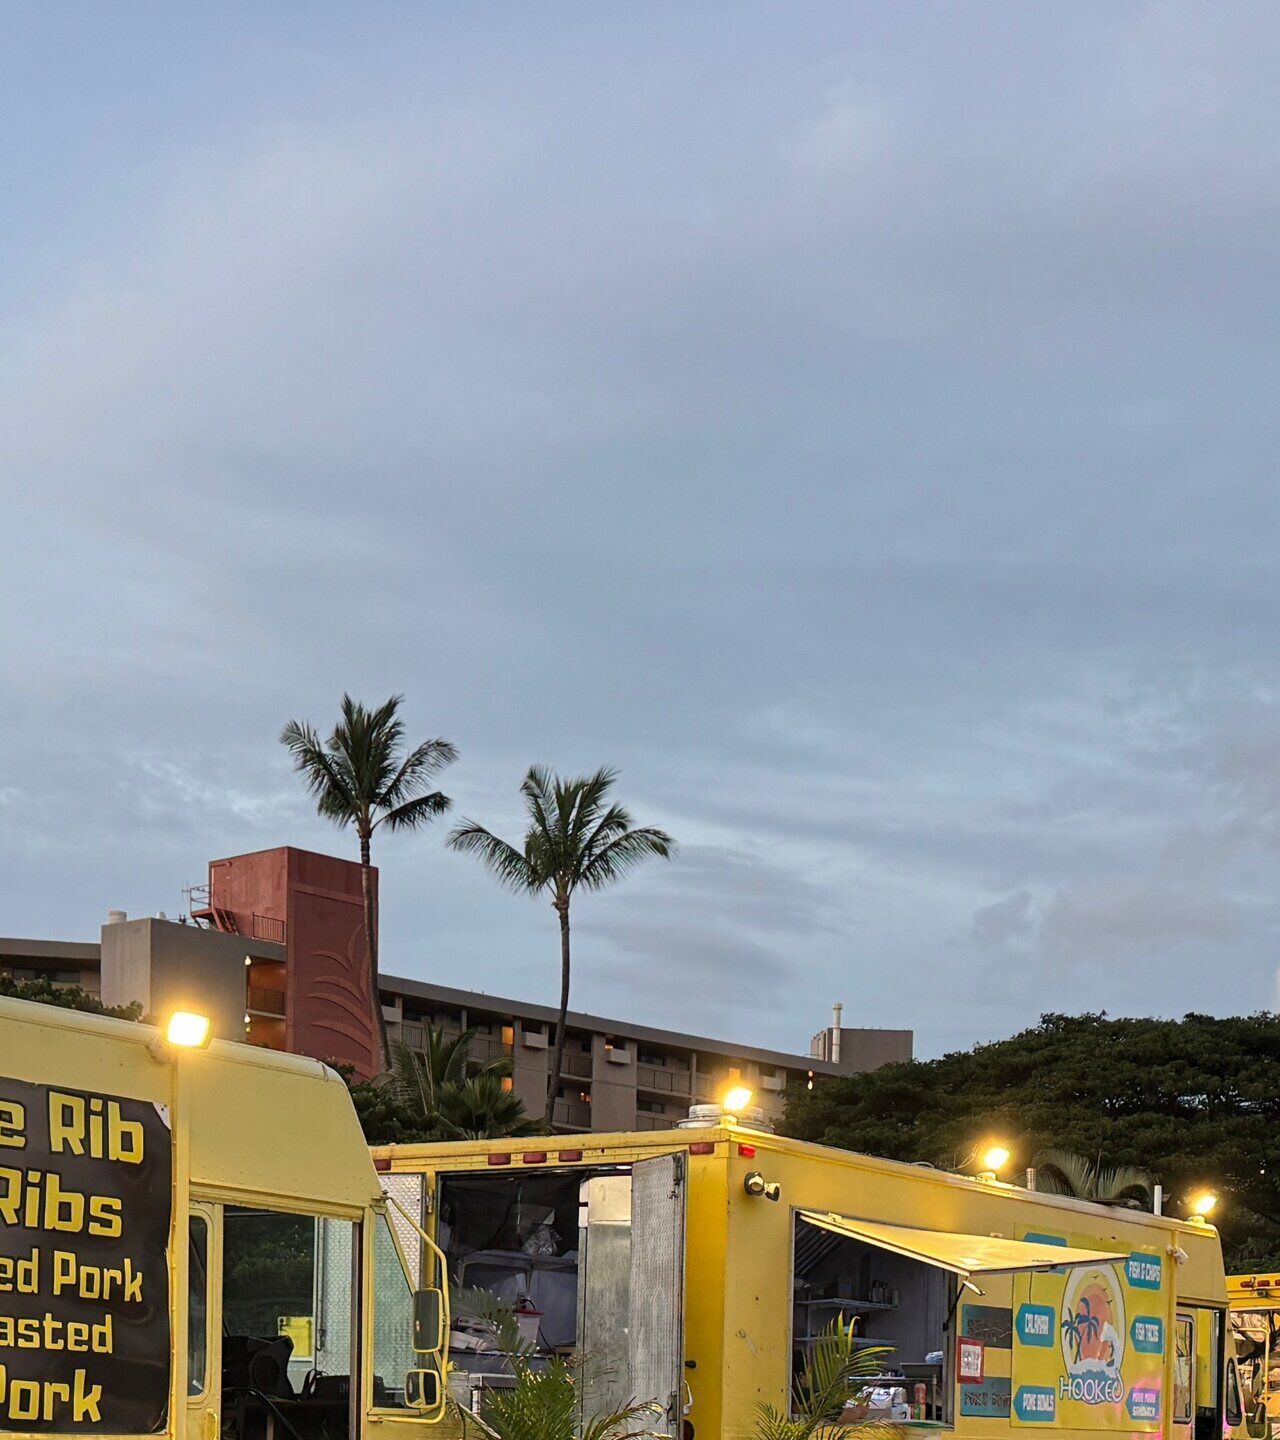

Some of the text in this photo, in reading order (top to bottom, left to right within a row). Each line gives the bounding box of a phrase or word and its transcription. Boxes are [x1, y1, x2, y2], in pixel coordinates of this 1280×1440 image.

[48, 1090, 144, 1164] Rib
[52, 1249, 144, 1303] Pork
[1059, 1367, 1124, 1404] HOOKED
